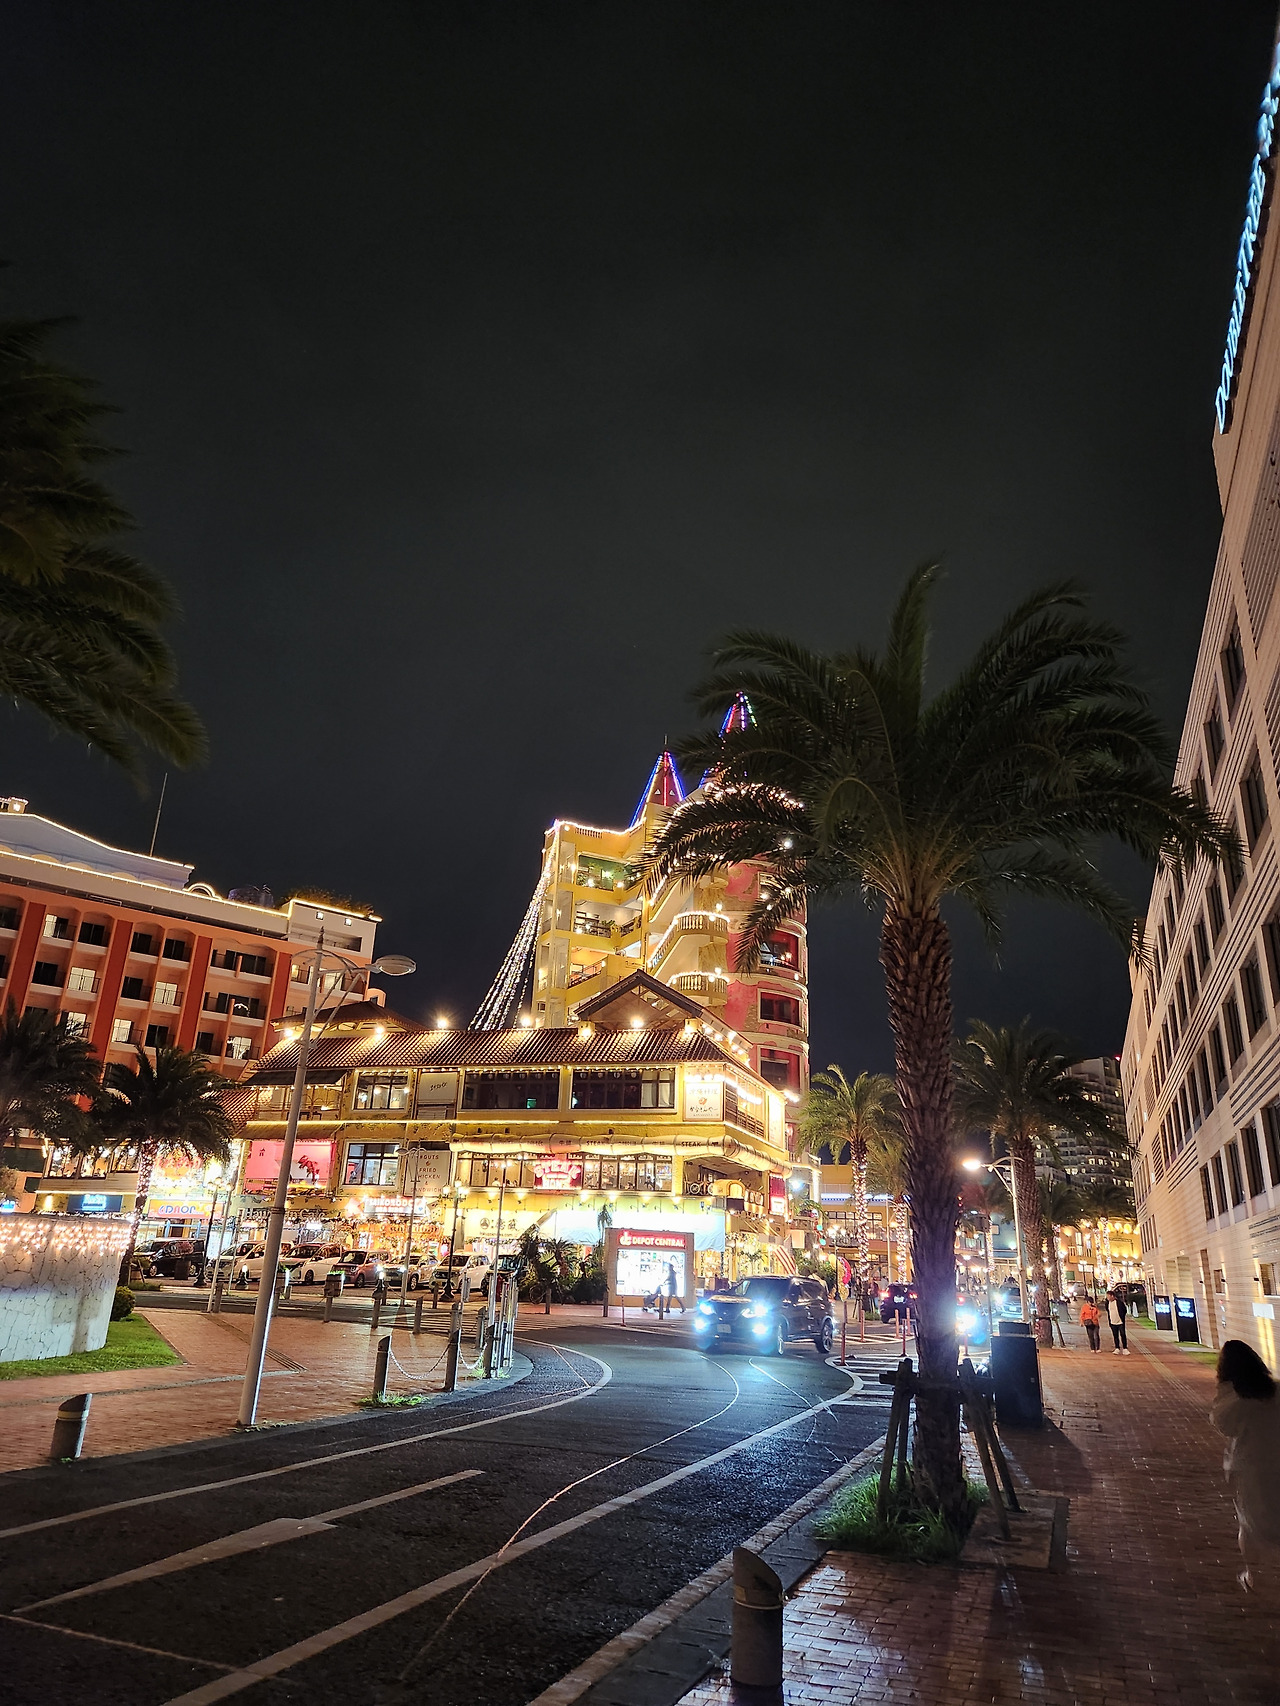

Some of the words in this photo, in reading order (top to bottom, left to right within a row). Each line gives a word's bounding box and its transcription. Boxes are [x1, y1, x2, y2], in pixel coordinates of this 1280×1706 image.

[534, 1159, 581, 1180] STEAK
[632, 1236, 654, 1246] DEPOT
[654, 1237, 685, 1248] CENTRAL
